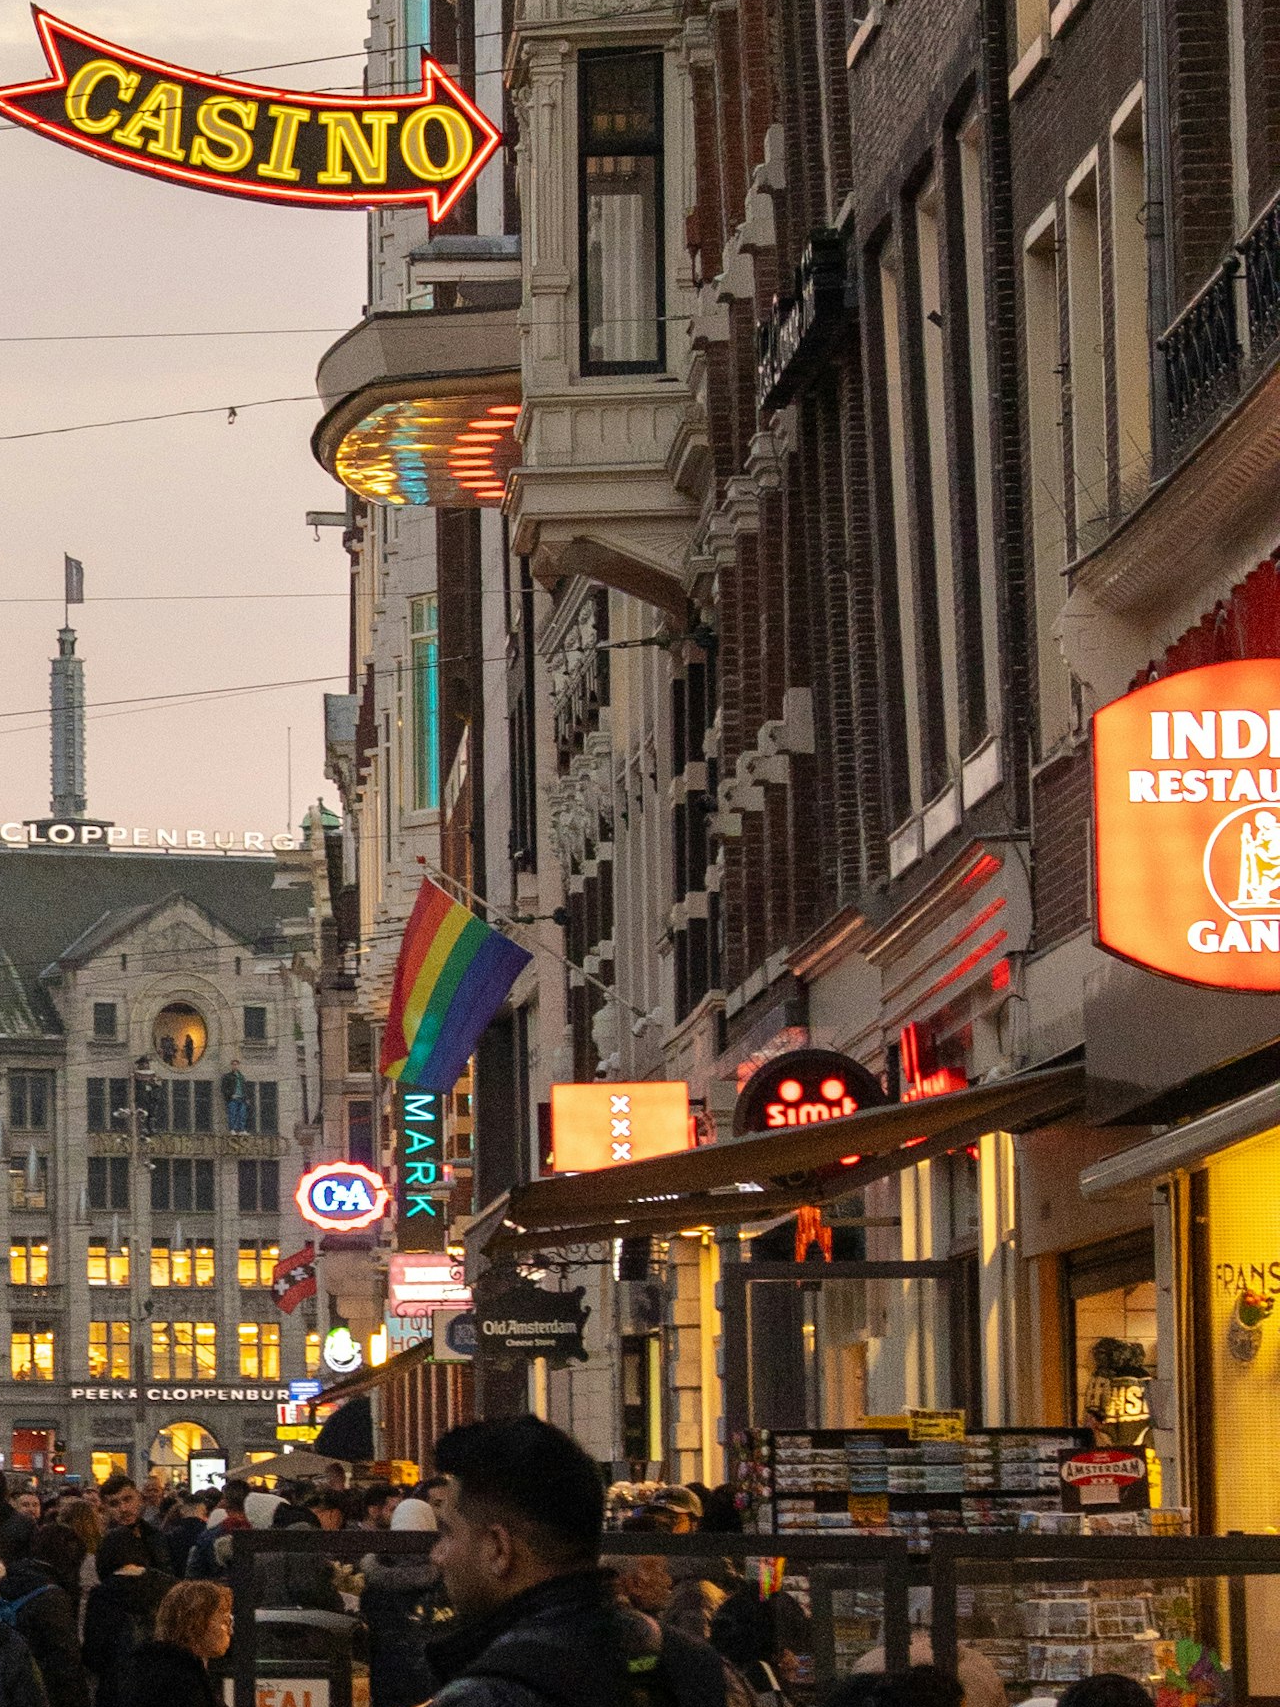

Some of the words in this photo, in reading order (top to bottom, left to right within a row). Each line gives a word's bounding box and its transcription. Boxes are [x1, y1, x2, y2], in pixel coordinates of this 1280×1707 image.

[65, 59, 473, 184] CASINO
[0, 822, 295, 851] CLOPPENBURG
[404, 1094, 436, 1218] MARK
[312, 1179, 375, 1211] C&A
[483, 1319, 506, 1335] Old
[507, 1319, 577, 1335] Amsterdam
[505, 1339, 534, 1347] Cheese
[535, 1339, 556, 1347] Store
[71, 1388, 124, 1400] PEEK
[147, 1388, 289, 1401] CLOPPENBUR
[1066, 1459, 1140, 1477] AMSTERDAM
